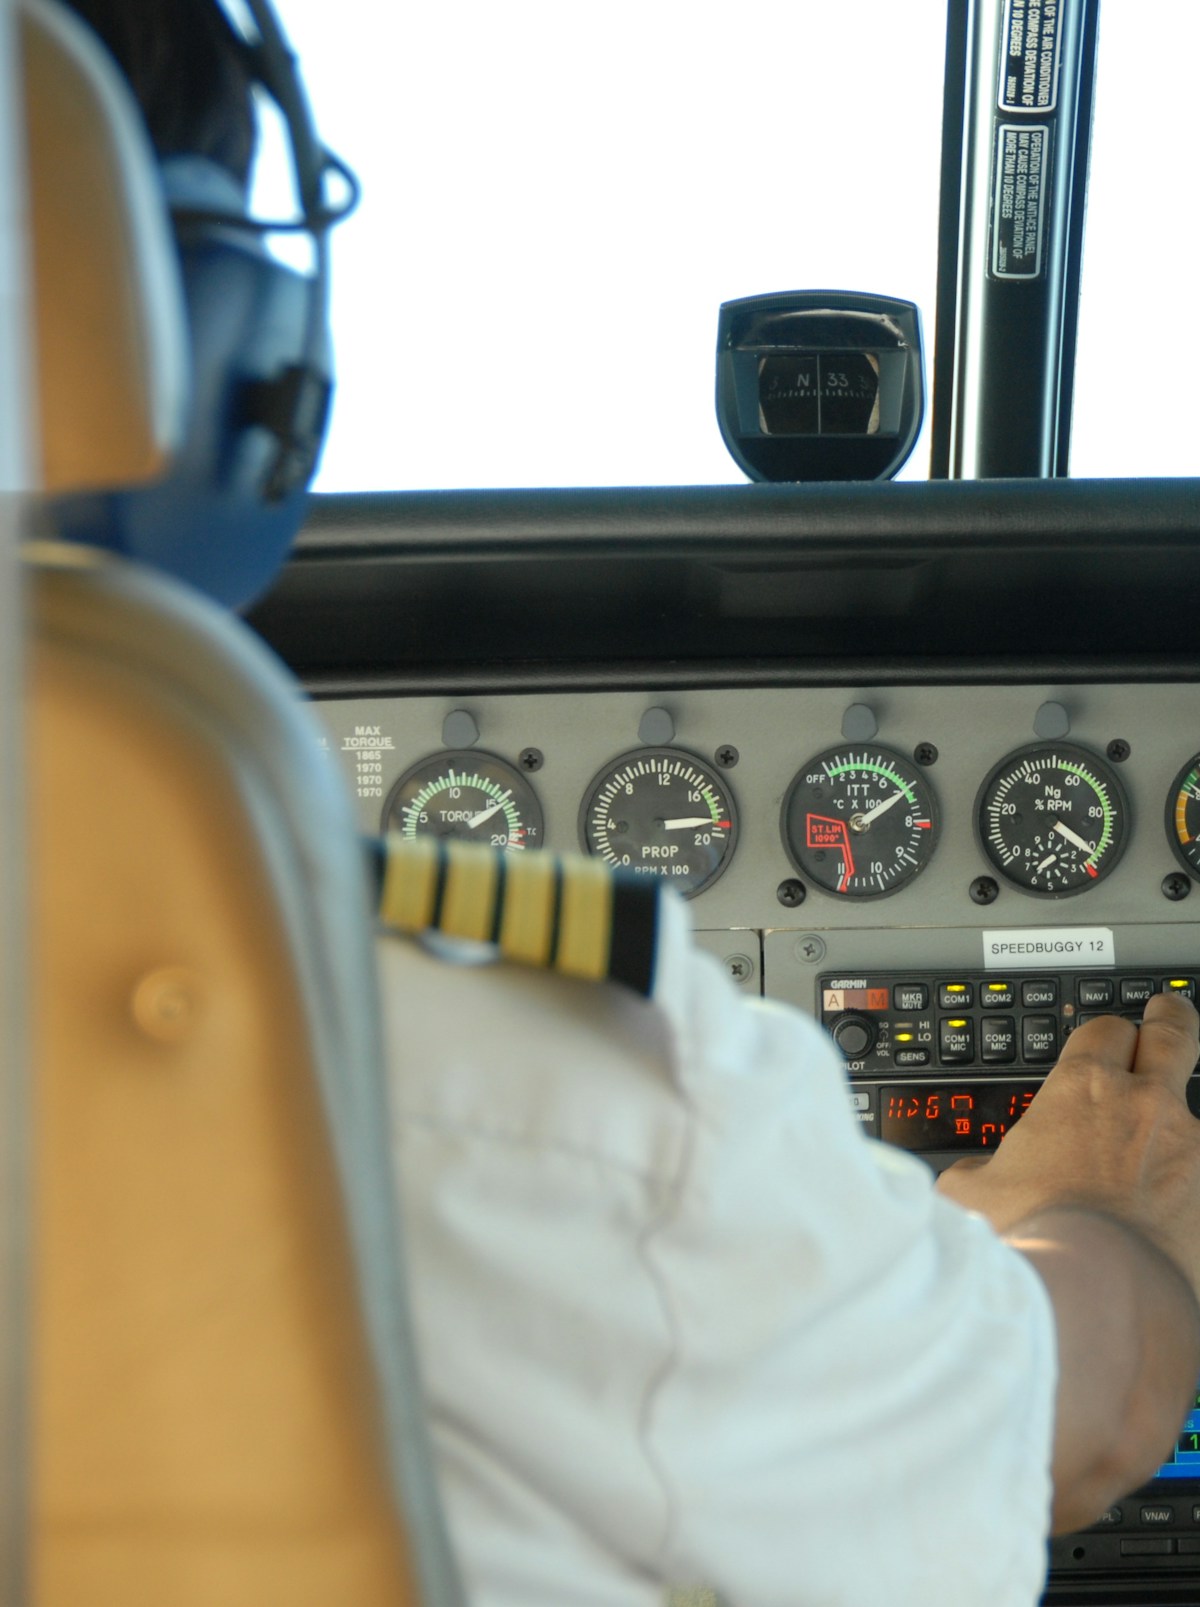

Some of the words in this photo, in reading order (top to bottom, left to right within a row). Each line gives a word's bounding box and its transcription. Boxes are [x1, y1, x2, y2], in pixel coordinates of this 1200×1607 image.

[1012, 9, 1024, 18] 10
[1044, 6, 1055, 18] OF
[1025, 9, 1040, 49] COMPASS
[1043, 18, 1055, 35] THE
[1009, 19, 1023, 57] DEGREES
[1041, 36, 1053, 50] AIR
[1022, 50, 1037, 93] DEVIATION
[1037, 51, 1052, 106] CONDITIONER
[1022, 94, 1034, 106] OF
[1006, 131, 1017, 153] MORE
[1018, 132, 1030, 148] MAY
[1029, 132, 1042, 173] OPERATION
[1004, 154, 1016, 173] THAN
[1016, 149, 1029, 173] CAUSE
[1003, 175, 1014, 184] 10
[1028, 174, 1040, 185] OF
[1014, 174, 1027, 210] COMPASS
[1027, 186, 1039, 199] THE
[1002, 184, 1013, 219] DEGREES
[1025, 200, 1038, 231] ANTI-ICE
[1013, 210, 1026, 247] DEVIATION
[1024, 232, 1036, 256] PANEL
[1012, 248, 1023, 259] OF
[797, 374, 810, 387] N
[828, 373, 849, 387] 33
[355, 727, 381, 735] MAX
[344, 737, 392, 747] TORQUE
[357, 751, 381, 760] 1865
[357, 763, 382, 772] 1970
[357, 776, 382, 785] 1970
[658, 774, 670, 785] 12
[806, 775, 825, 783] OFF
[1025, 774, 1040, 784] 40
[1065, 775, 1080, 786] 60
[357, 788, 382, 797] 1970
[450, 788, 461, 798] 10
[847, 785, 870, 796] ITT
[1045, 786, 1061, 799] Ng
[688, 791, 701, 802] 16
[1002, 804, 1016, 815] 20
[1047, 800, 1072, 811] RPM
[1089, 807, 1103, 817] 80
[491, 835, 507, 846] 20
[695, 834, 710, 845] 20
[642, 846, 678, 858] PROP
[672, 865, 689, 874] 100
[871, 862, 883, 873] 10
[991, 941, 1083, 954] SPEEDBUGGY
[1090, 941, 1104, 951] 12
[831, 980, 866, 988] GARMIN
[902, 994, 922, 1002] MKR
[944, 995, 970, 1004] COM1
[985, 994, 1011, 1003] COM2
[1027, 993, 1053, 1002] COM3
[1086, 993, 1109, 1001] NAV1
[1127, 992, 1150, 1000] NAV2
[902, 1002, 922, 1010] MUTE
[920, 1022, 930, 1030] HI
[918, 1033, 932, 1042] LO
[944, 1035, 970, 1043] COM1
[986, 1035, 1011, 1043] COM2
[1027, 1034, 1053, 1042] COM3
[951, 1043, 966, 1051] MIC
[991, 1042, 1007, 1050] MIC
[1033, 1041, 1048, 1049] MIC
[900, 1053, 926, 1061] SENS
[1145, 1512, 1170, 1521] VNAV
